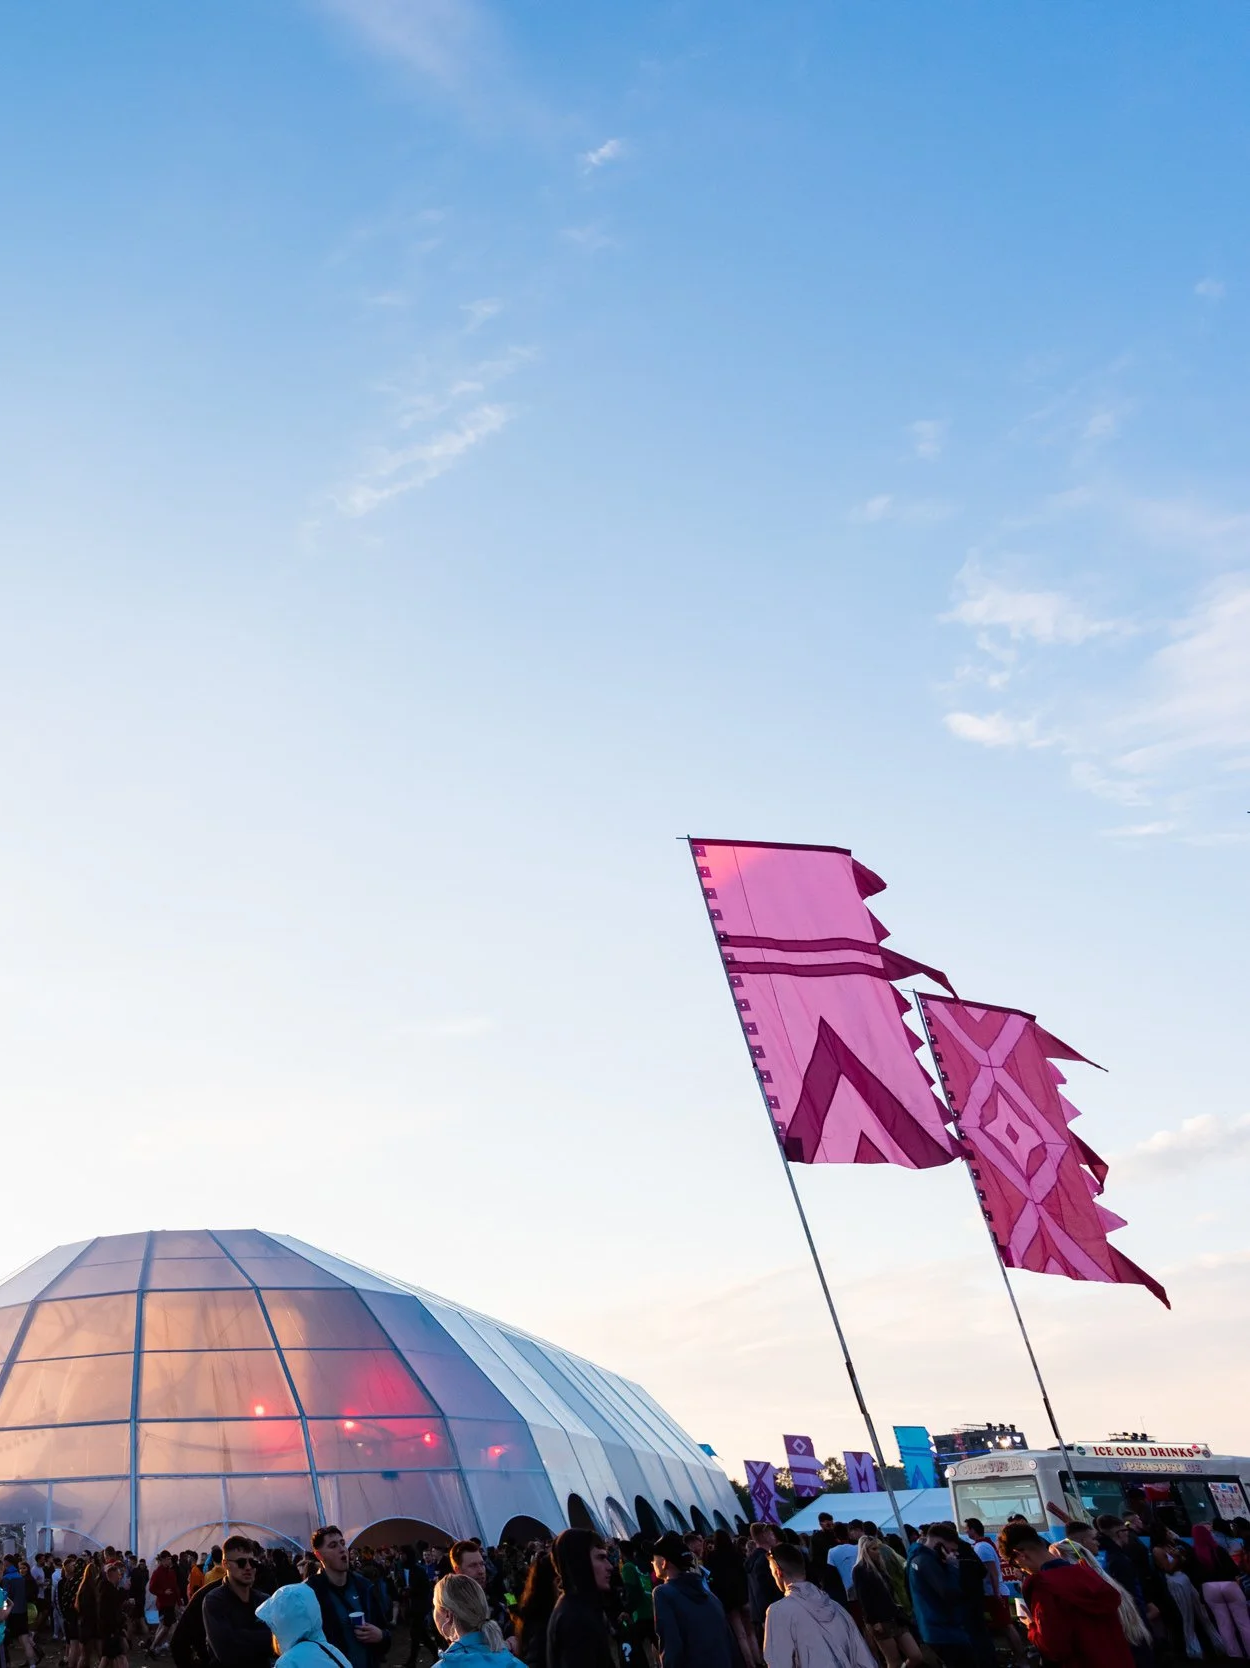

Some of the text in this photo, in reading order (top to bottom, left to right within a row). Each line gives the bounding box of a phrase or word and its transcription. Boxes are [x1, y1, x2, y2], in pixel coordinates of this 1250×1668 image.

[1093, 1446, 1194, 1458] ICE COLD DRINKS
[1114, 1462, 1203, 1473] SUPER SOFT ICE
